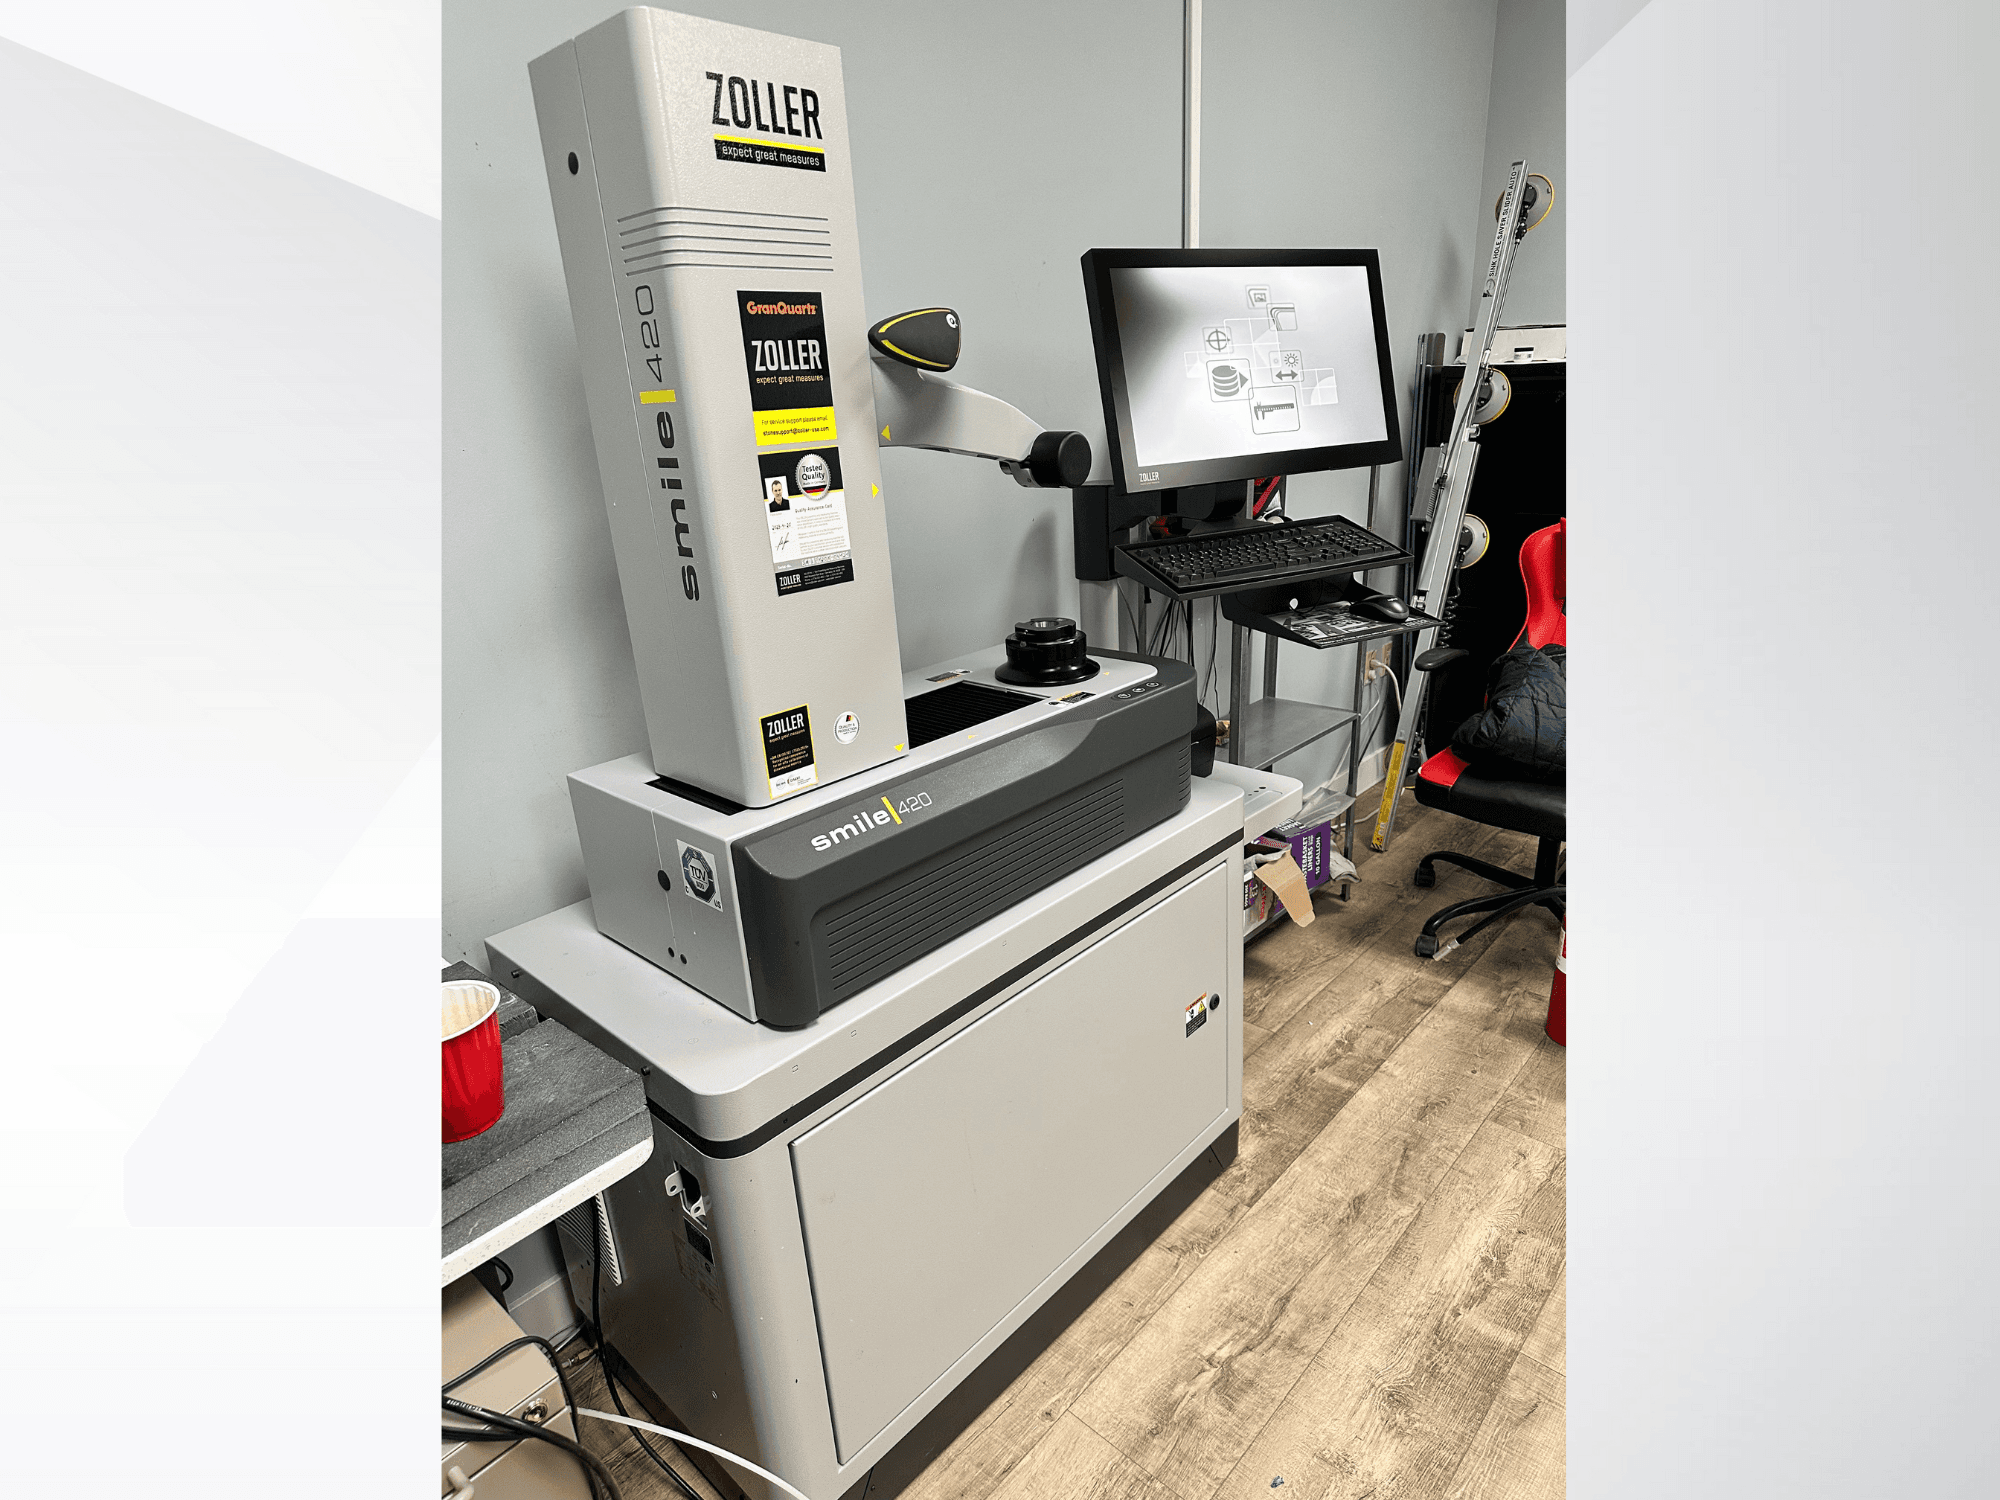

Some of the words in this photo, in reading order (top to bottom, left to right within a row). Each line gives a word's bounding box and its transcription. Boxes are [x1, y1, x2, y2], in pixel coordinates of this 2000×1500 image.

[706, 71, 823, 140] ZOLLER
[722, 145, 753, 159] expect
[755, 150, 778, 162] great
[780, 153, 820, 166] measures
[1508, 171, 1517, 190] AUTO
[1502, 191, 1513, 216] SLIDER
[1497, 217, 1507, 240] SAVER
[1493, 241, 1502, 260] HOLE
[1489, 260, 1497, 277] SINK
[746, 301, 816, 315] GranQuartz
[635, 284, 663, 383] 420
[751, 339, 823, 372] ZOLLER
[756, 376, 777, 386] expect
[778, 375, 795, 385] great
[796, 374, 824, 383] measures
[801, 472, 826, 481] Quality
[802, 464, 823, 473] Tested
[1139, 471, 1160, 483] ZOLLER
[657, 411, 700, 601] smile
[779, 573, 801, 587] ZOLLER
[767, 713, 805, 738] ZOLLER
[810, 810, 892, 852] smile
[898, 791, 933, 815] 420
